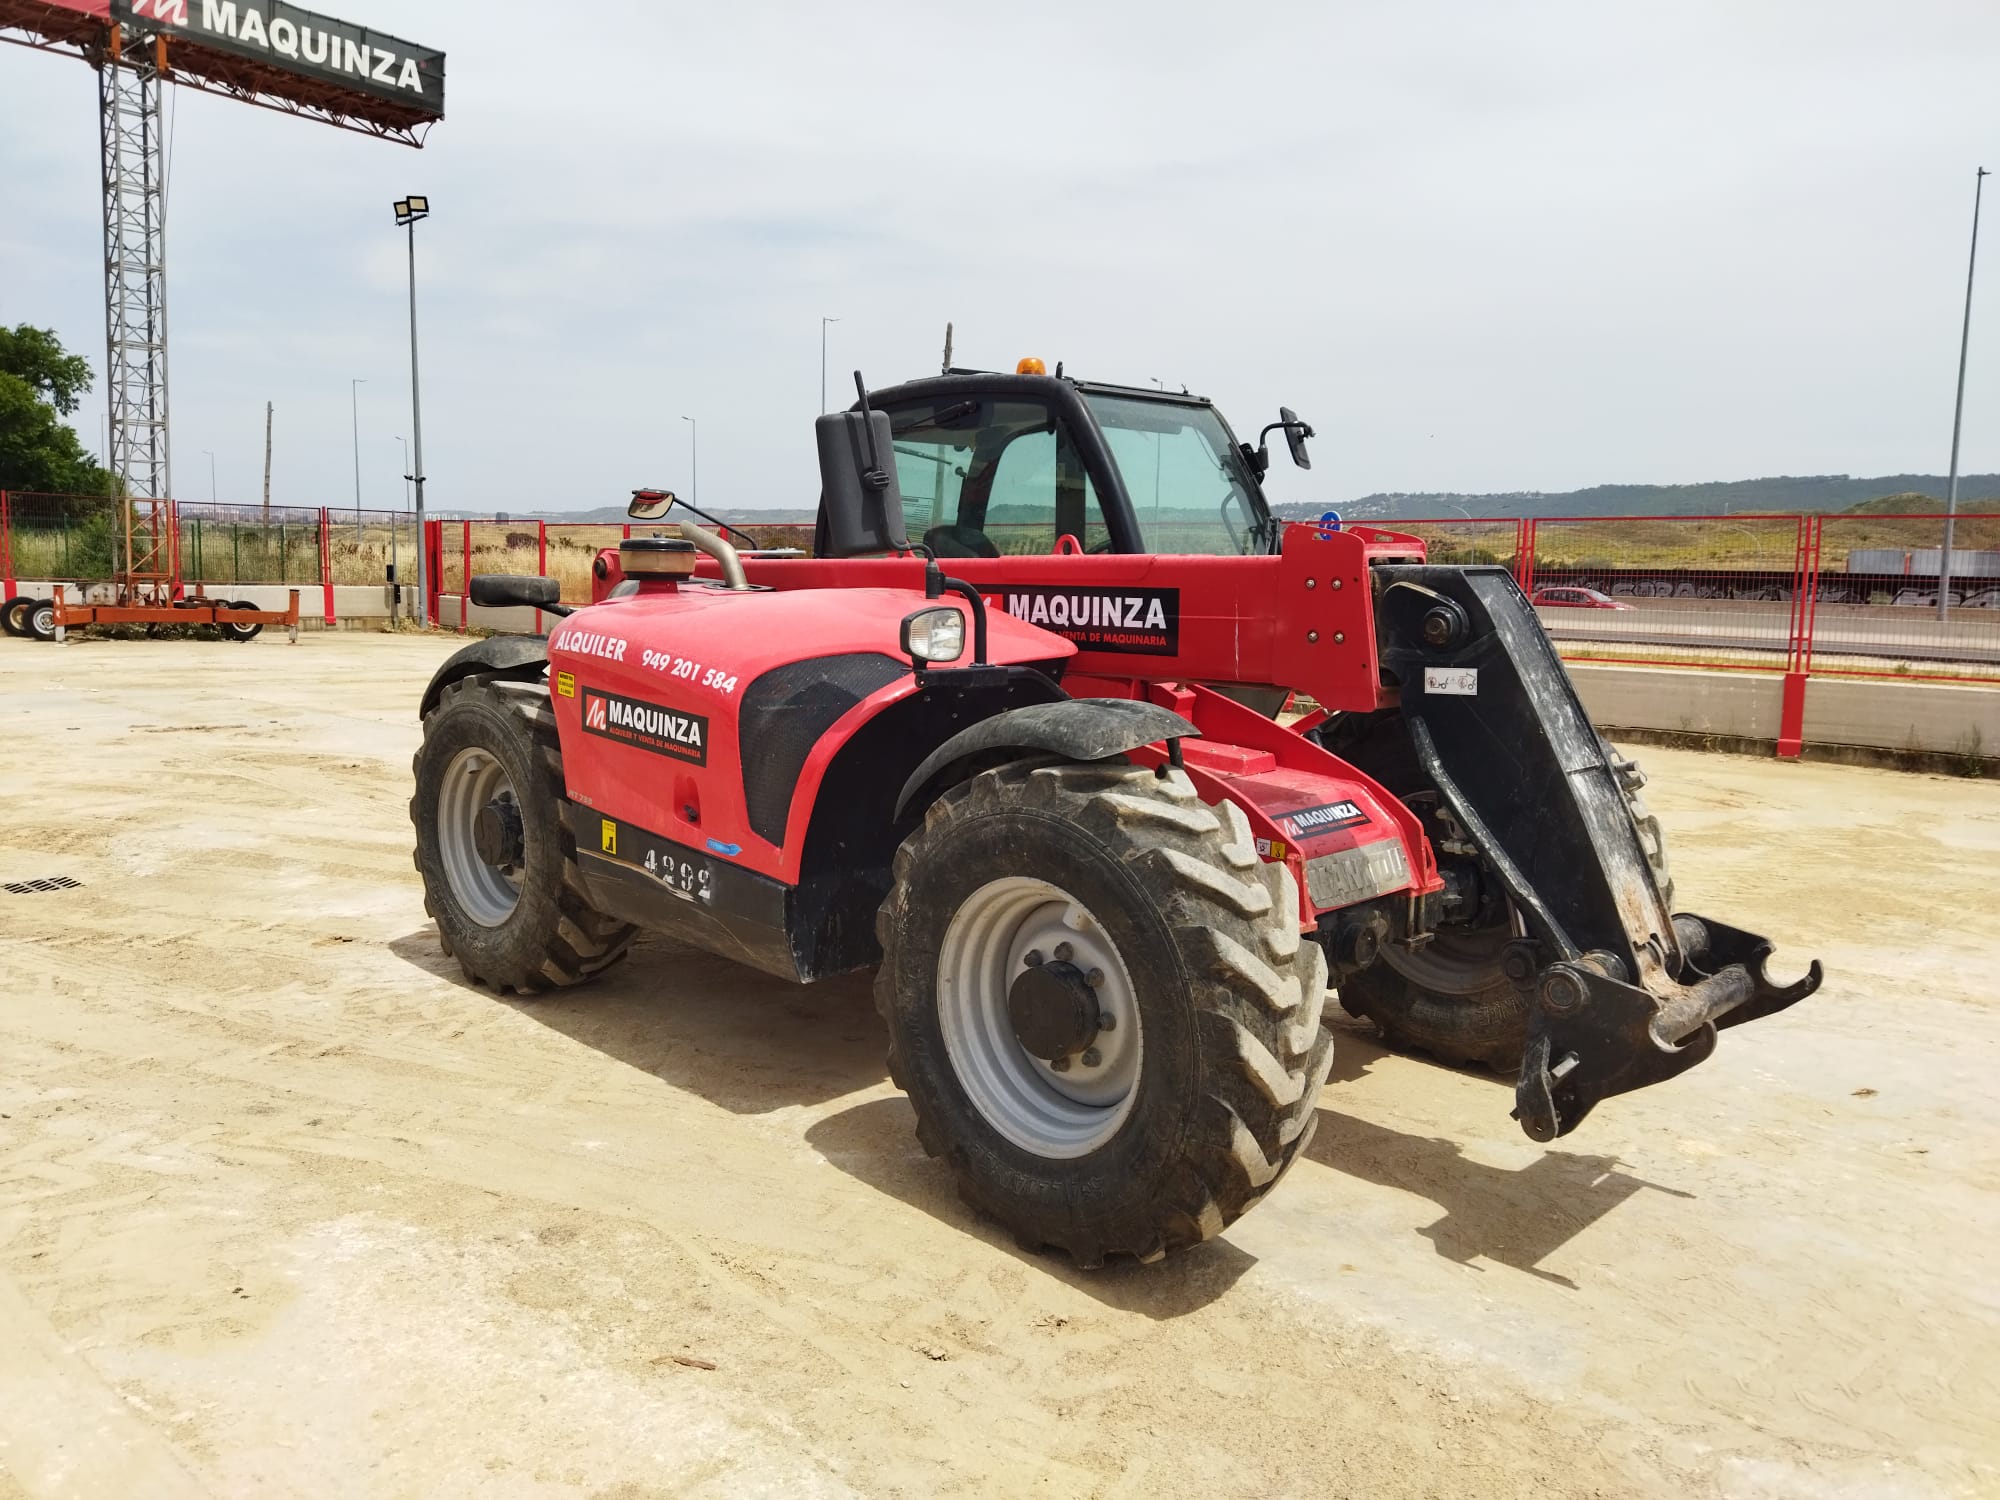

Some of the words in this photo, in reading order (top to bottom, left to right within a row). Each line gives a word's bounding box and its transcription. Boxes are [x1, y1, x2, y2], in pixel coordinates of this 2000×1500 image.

[202, 0, 424, 94] MAQUINZA
[1009, 594, 1167, 629] MAQUINZA
[1089, 632, 1101, 642] DE
[1103, 633, 1167, 646] MAQUINARIA
[555, 631, 627, 662] ALQUILER
[642, 650, 669, 672] 949
[673, 658, 700, 681] 201
[702, 668, 738, 694] 584
[609, 700, 702, 746] MAQUINZA
[1292, 803, 1362, 827] MAQUINZA
